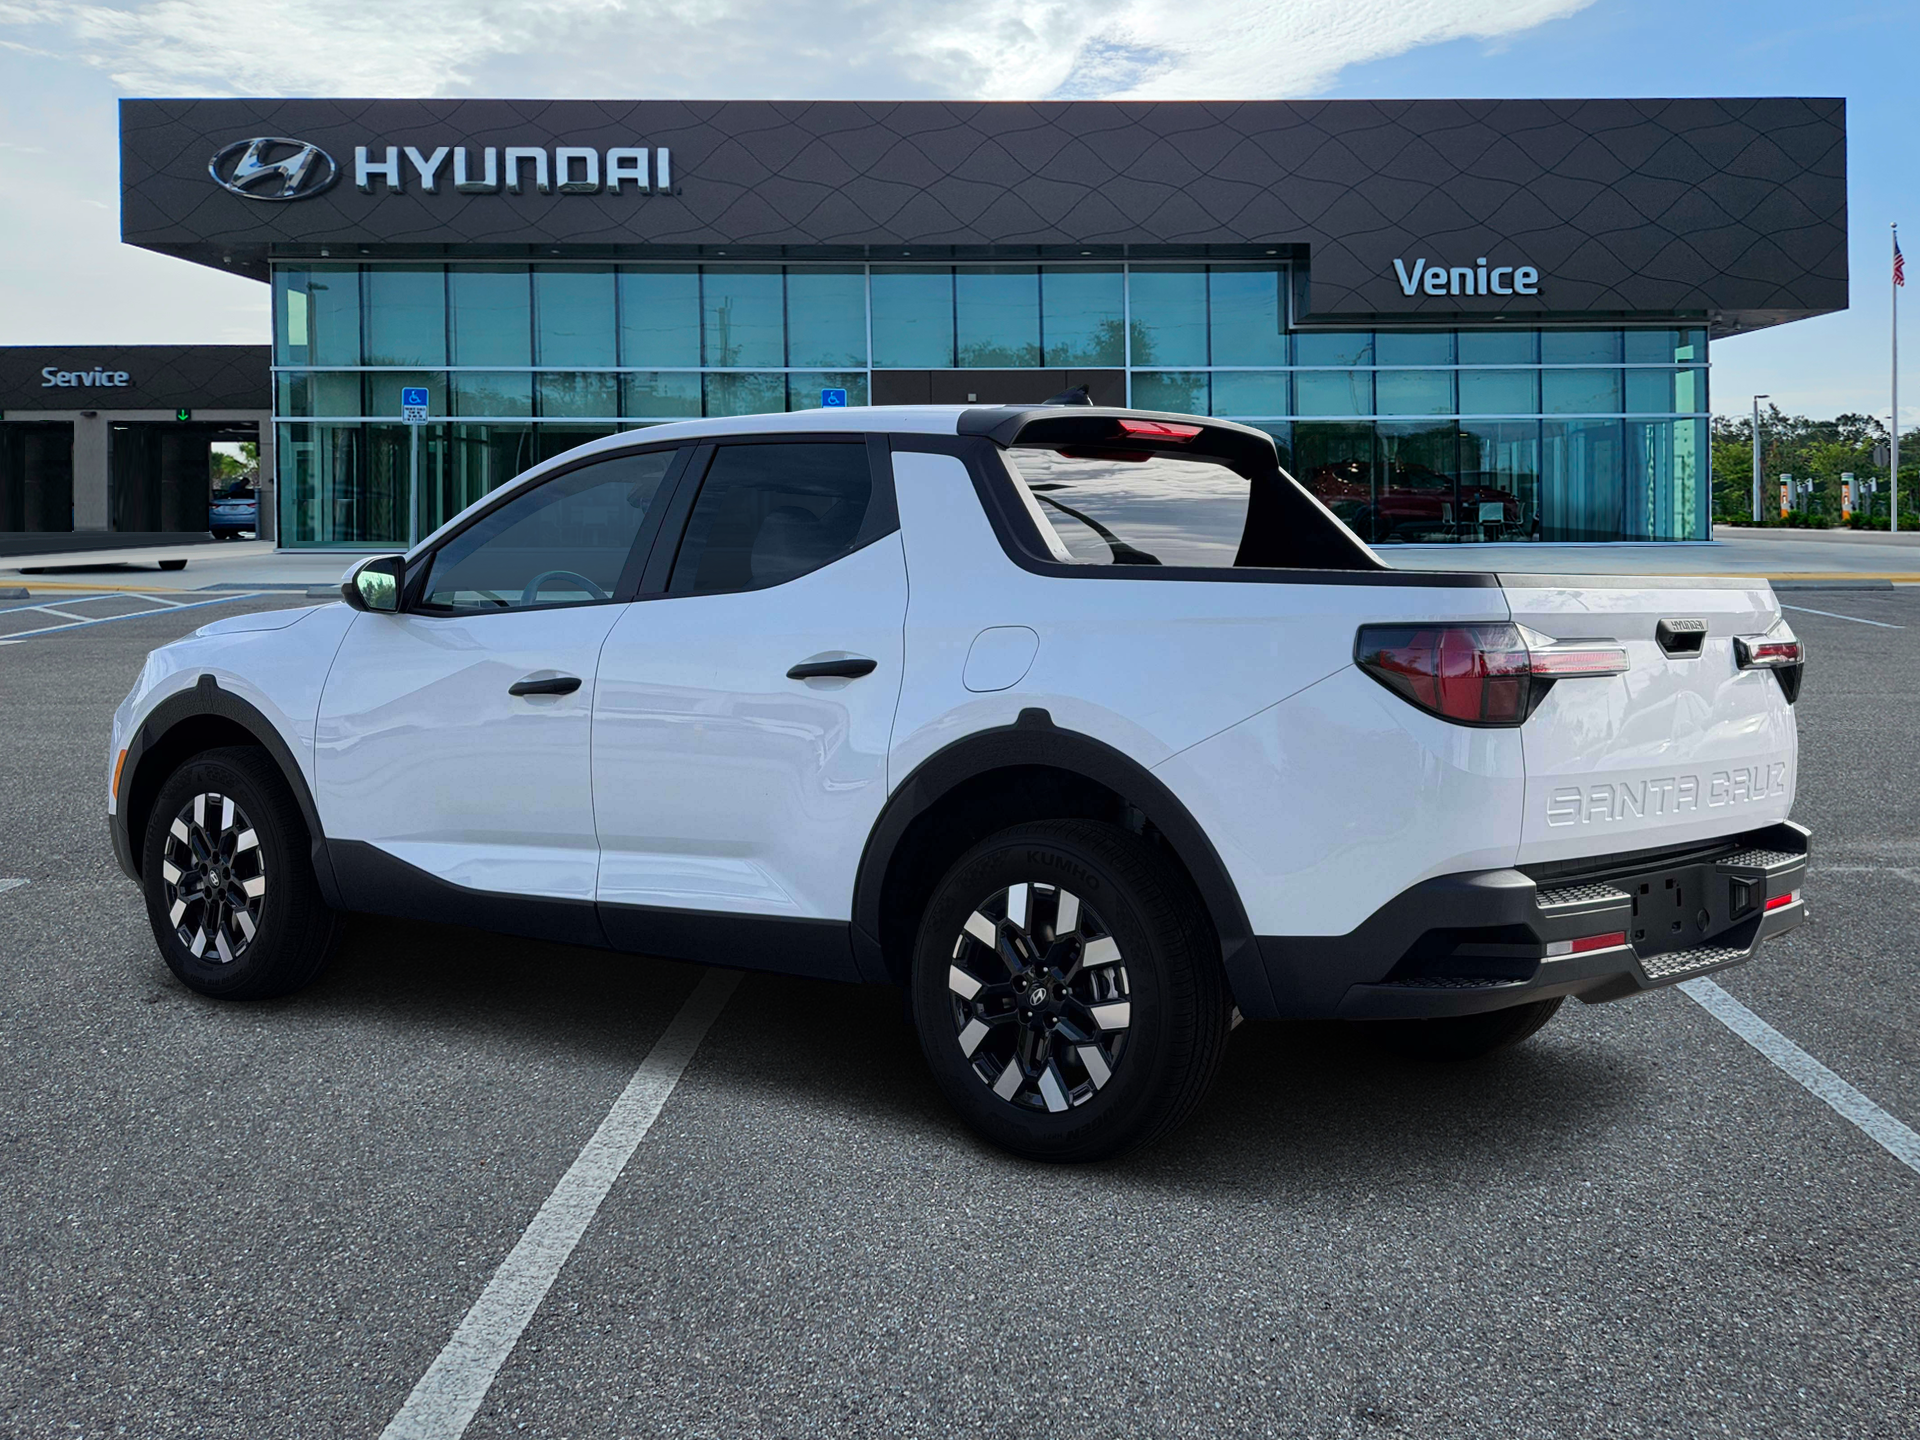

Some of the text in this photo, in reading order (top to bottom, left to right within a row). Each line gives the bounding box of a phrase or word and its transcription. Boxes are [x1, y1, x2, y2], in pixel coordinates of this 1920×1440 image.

[355, 146, 671, 195] HYUNDAI
[1392, 257, 1539, 296] Venice
[41, 366, 130, 387] Service
[1670, 620, 1705, 631] HYUNDAI
[1547, 762, 1786, 827] SANTA CRUZ
[1027, 850, 1100, 891] KUMHO
